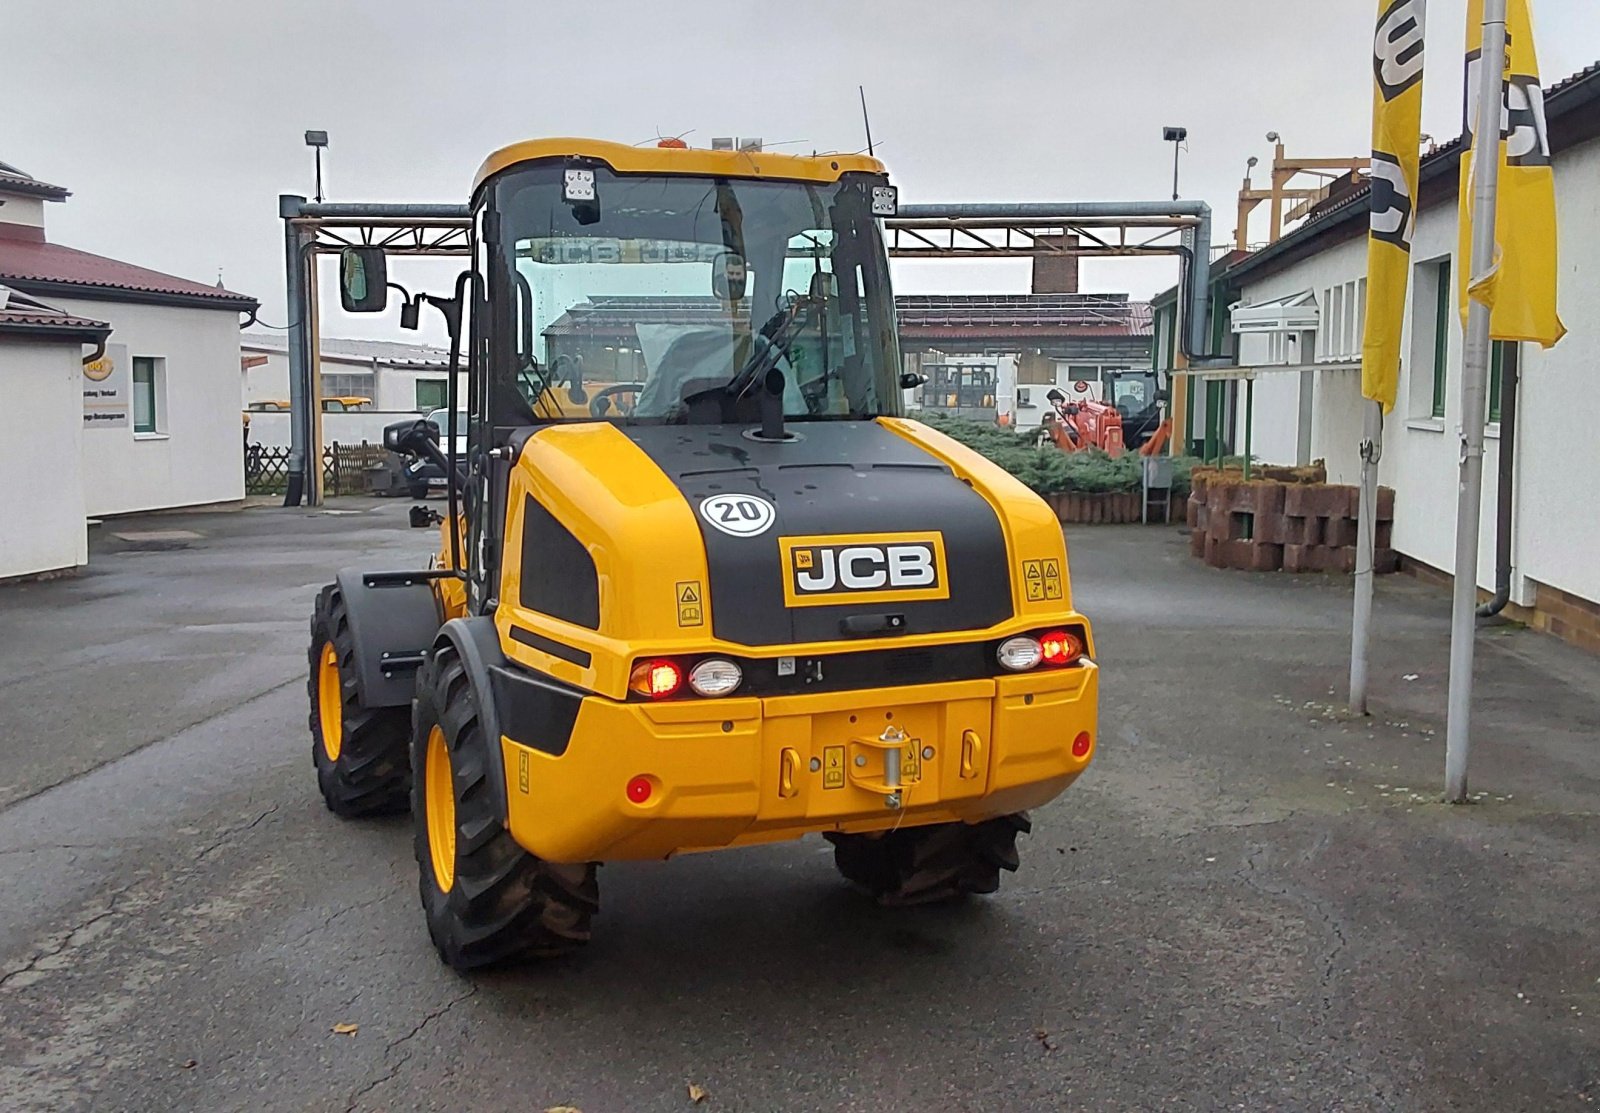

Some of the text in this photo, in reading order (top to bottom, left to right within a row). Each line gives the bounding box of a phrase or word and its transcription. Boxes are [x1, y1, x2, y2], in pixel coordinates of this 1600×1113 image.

[541, 241, 620, 263] JCB
[714, 501, 762, 523] 20
[797, 545, 935, 591] JCB
